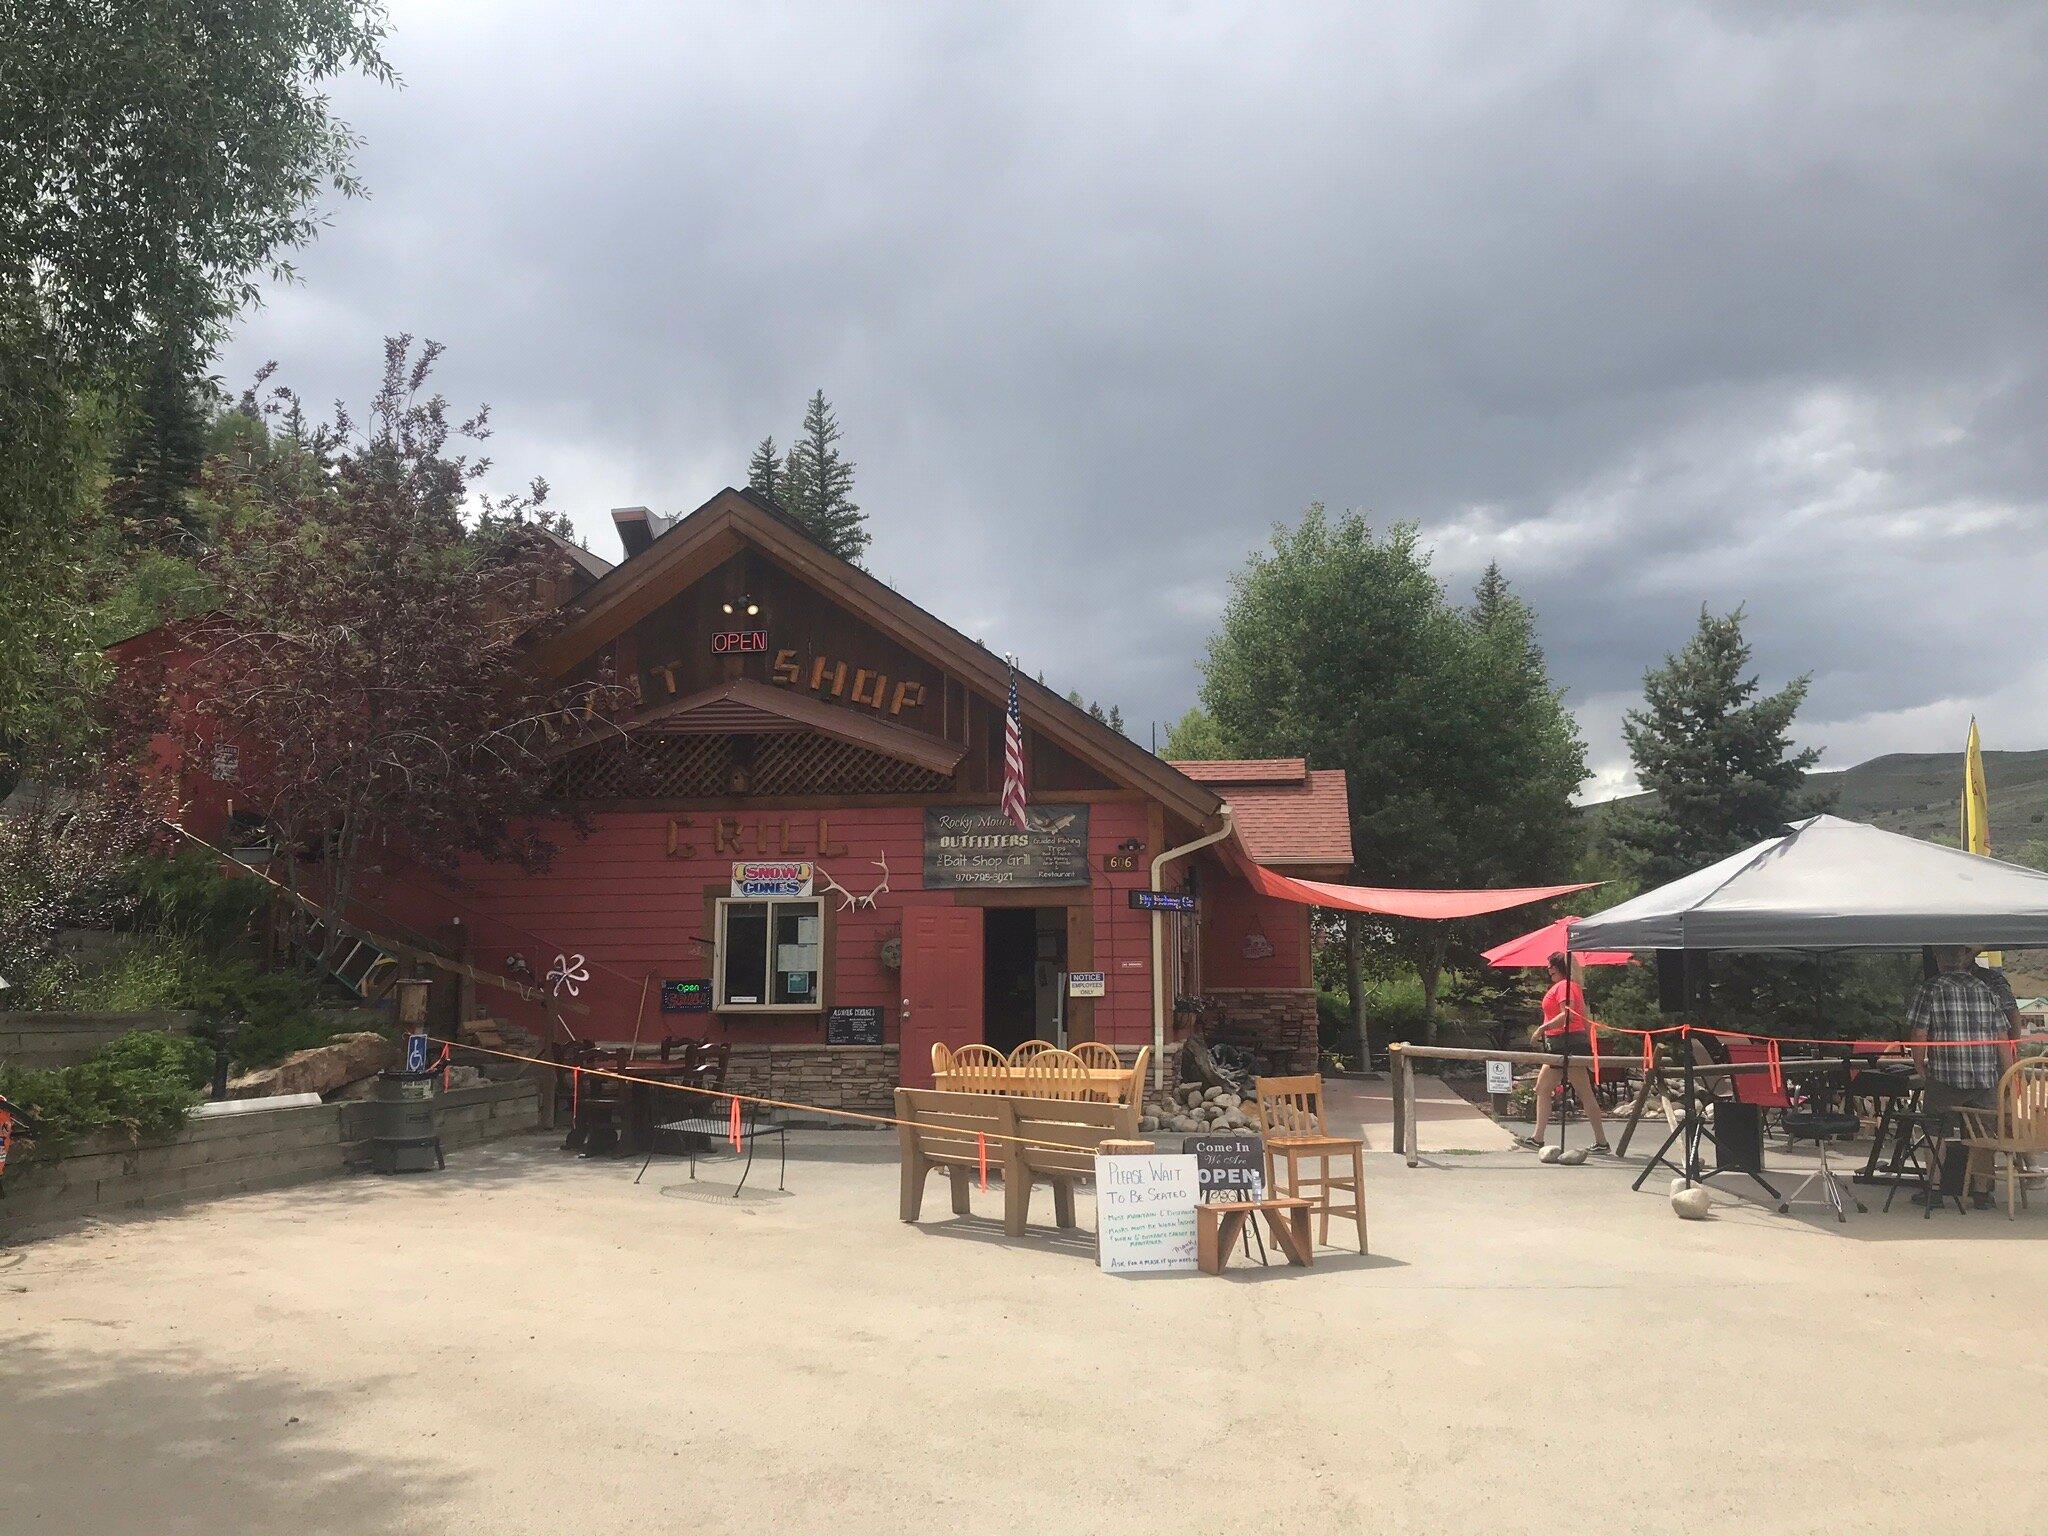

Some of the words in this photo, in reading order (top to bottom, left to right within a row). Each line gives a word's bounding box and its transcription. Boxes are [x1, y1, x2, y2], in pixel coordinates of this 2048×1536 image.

[714, 633, 766, 652] OPEN
[772, 649, 926, 715] SHOP
[939, 813, 973, 833] Rocky
[940, 835, 1029, 848] OUTFITTERS
[944, 854, 968, 867] Bait
[972, 854, 1003, 870] Shop
[1007, 853, 1031, 866] Grill
[1110, 856, 1132, 868] 606
[745, 865, 799, 879] SNOW
[1038, 870, 1076, 878] Restaurant
[742, 881, 800, 894] CONES
[676, 983, 700, 993] Open
[1196, 1142, 1233, 1152] Come
[1236, 1142, 1250, 1152] In
[1198, 1168, 1256, 1184] OPEN
